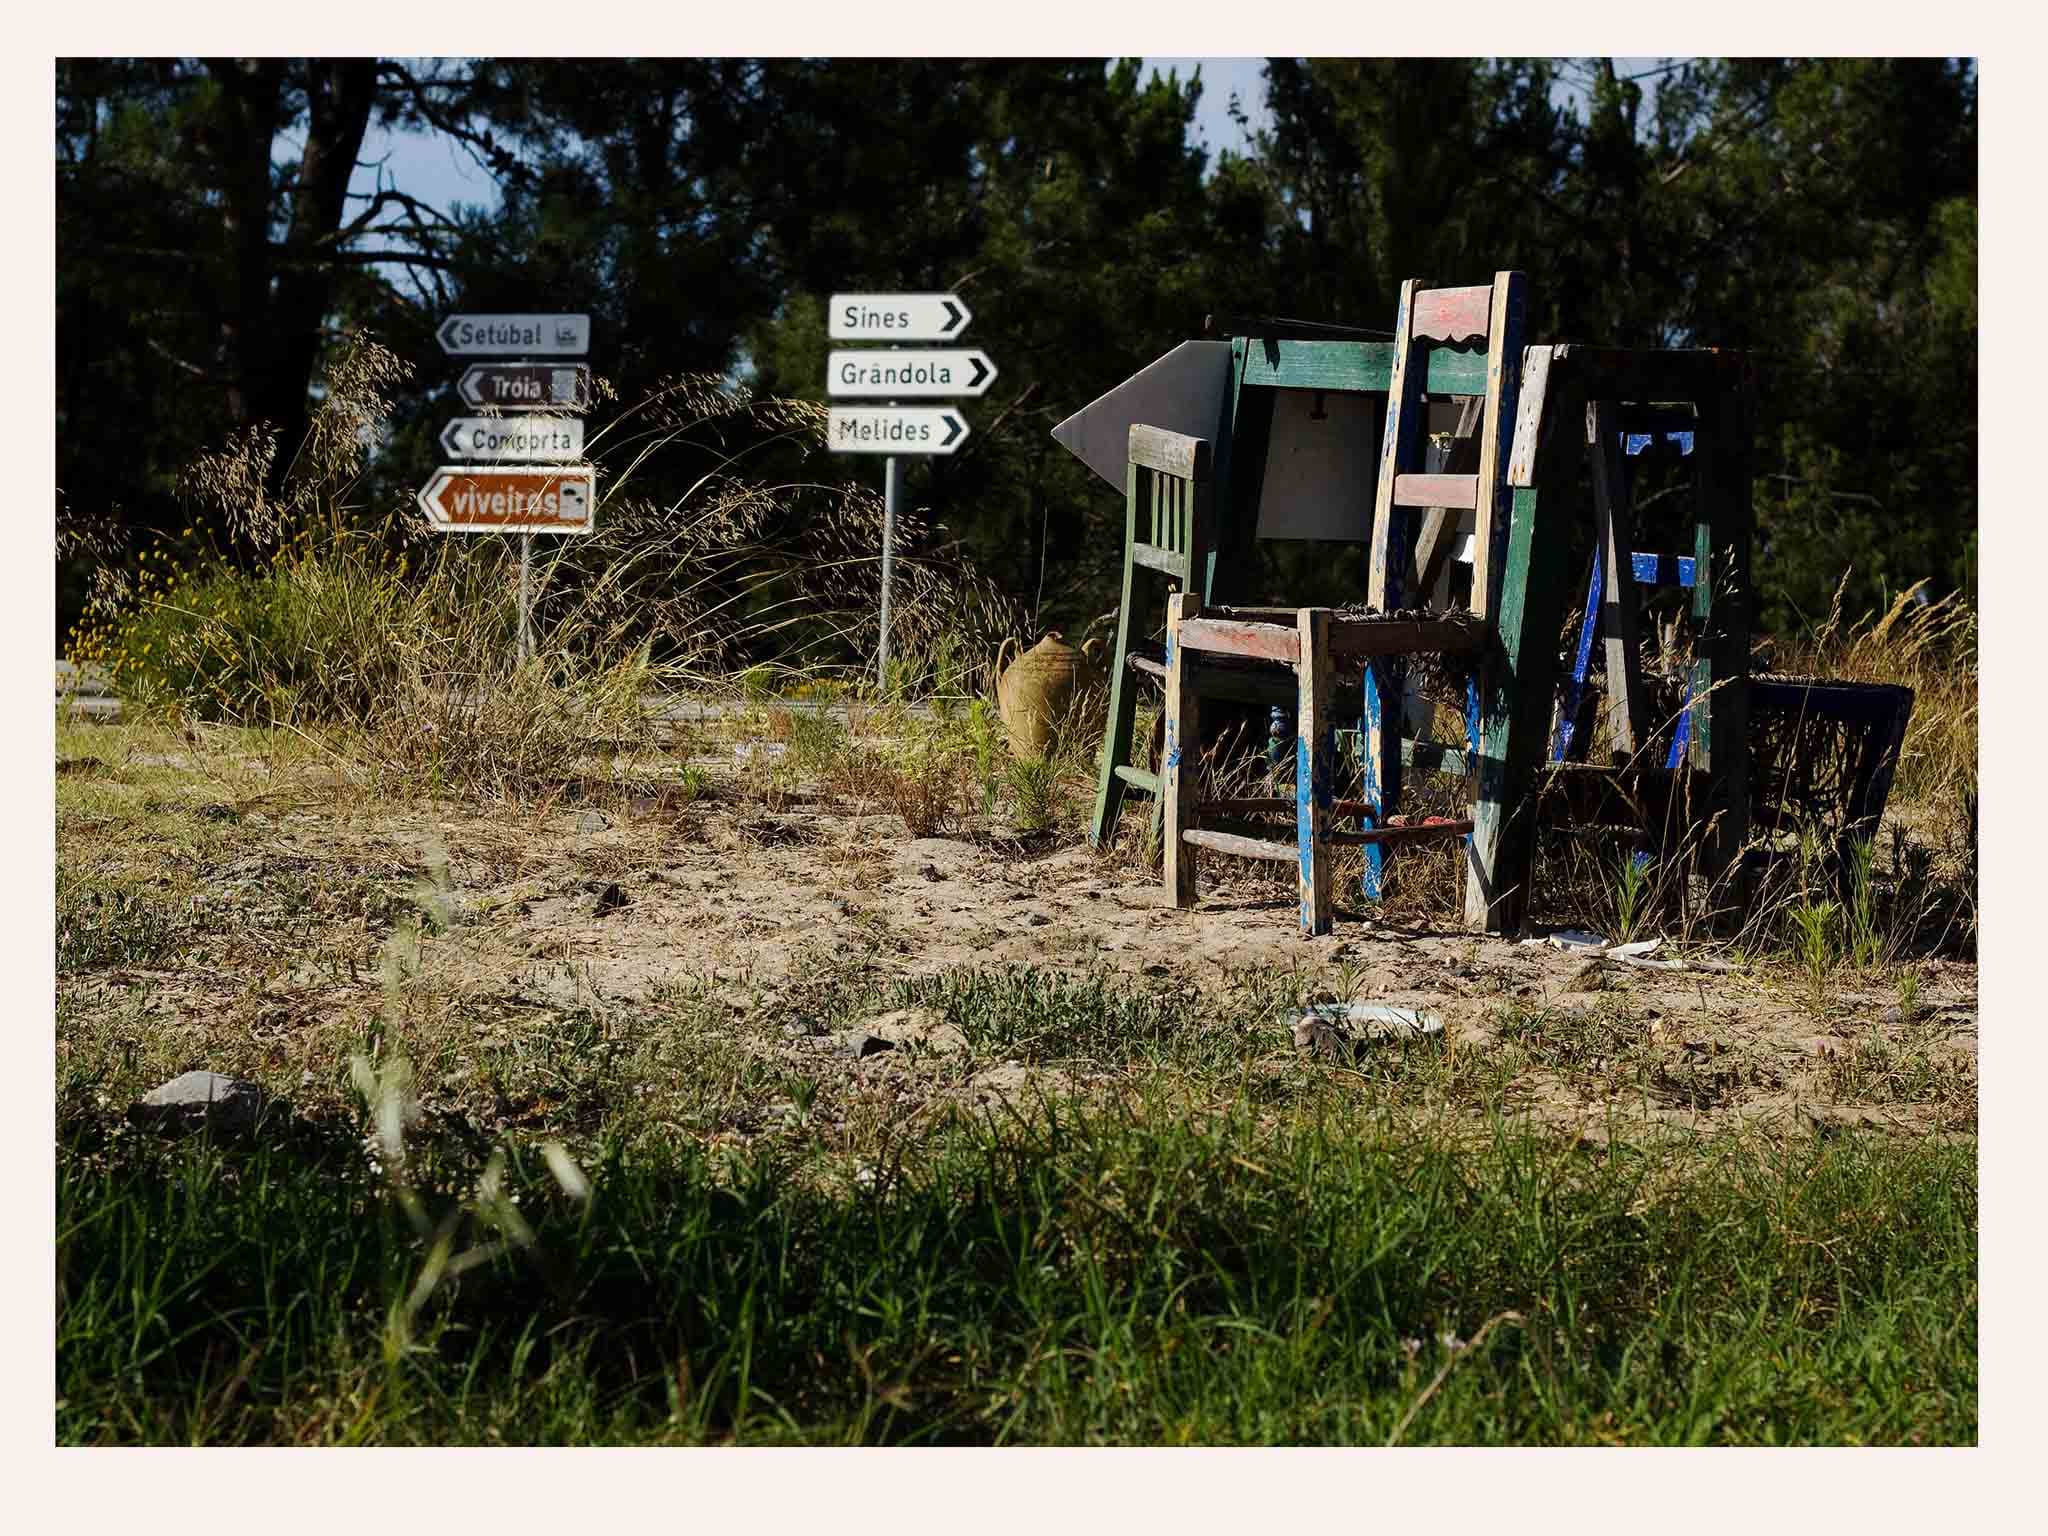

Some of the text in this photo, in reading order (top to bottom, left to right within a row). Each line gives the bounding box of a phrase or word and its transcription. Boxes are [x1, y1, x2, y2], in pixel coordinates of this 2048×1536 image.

[843, 306, 910, 328] Sines
[460, 323, 541, 345] Setúbal
[841, 362, 951, 385] Grândola
[491, 375, 541, 399] Tróia
[839, 418, 931, 441] Melides
[452, 483, 558, 516] viveiros
